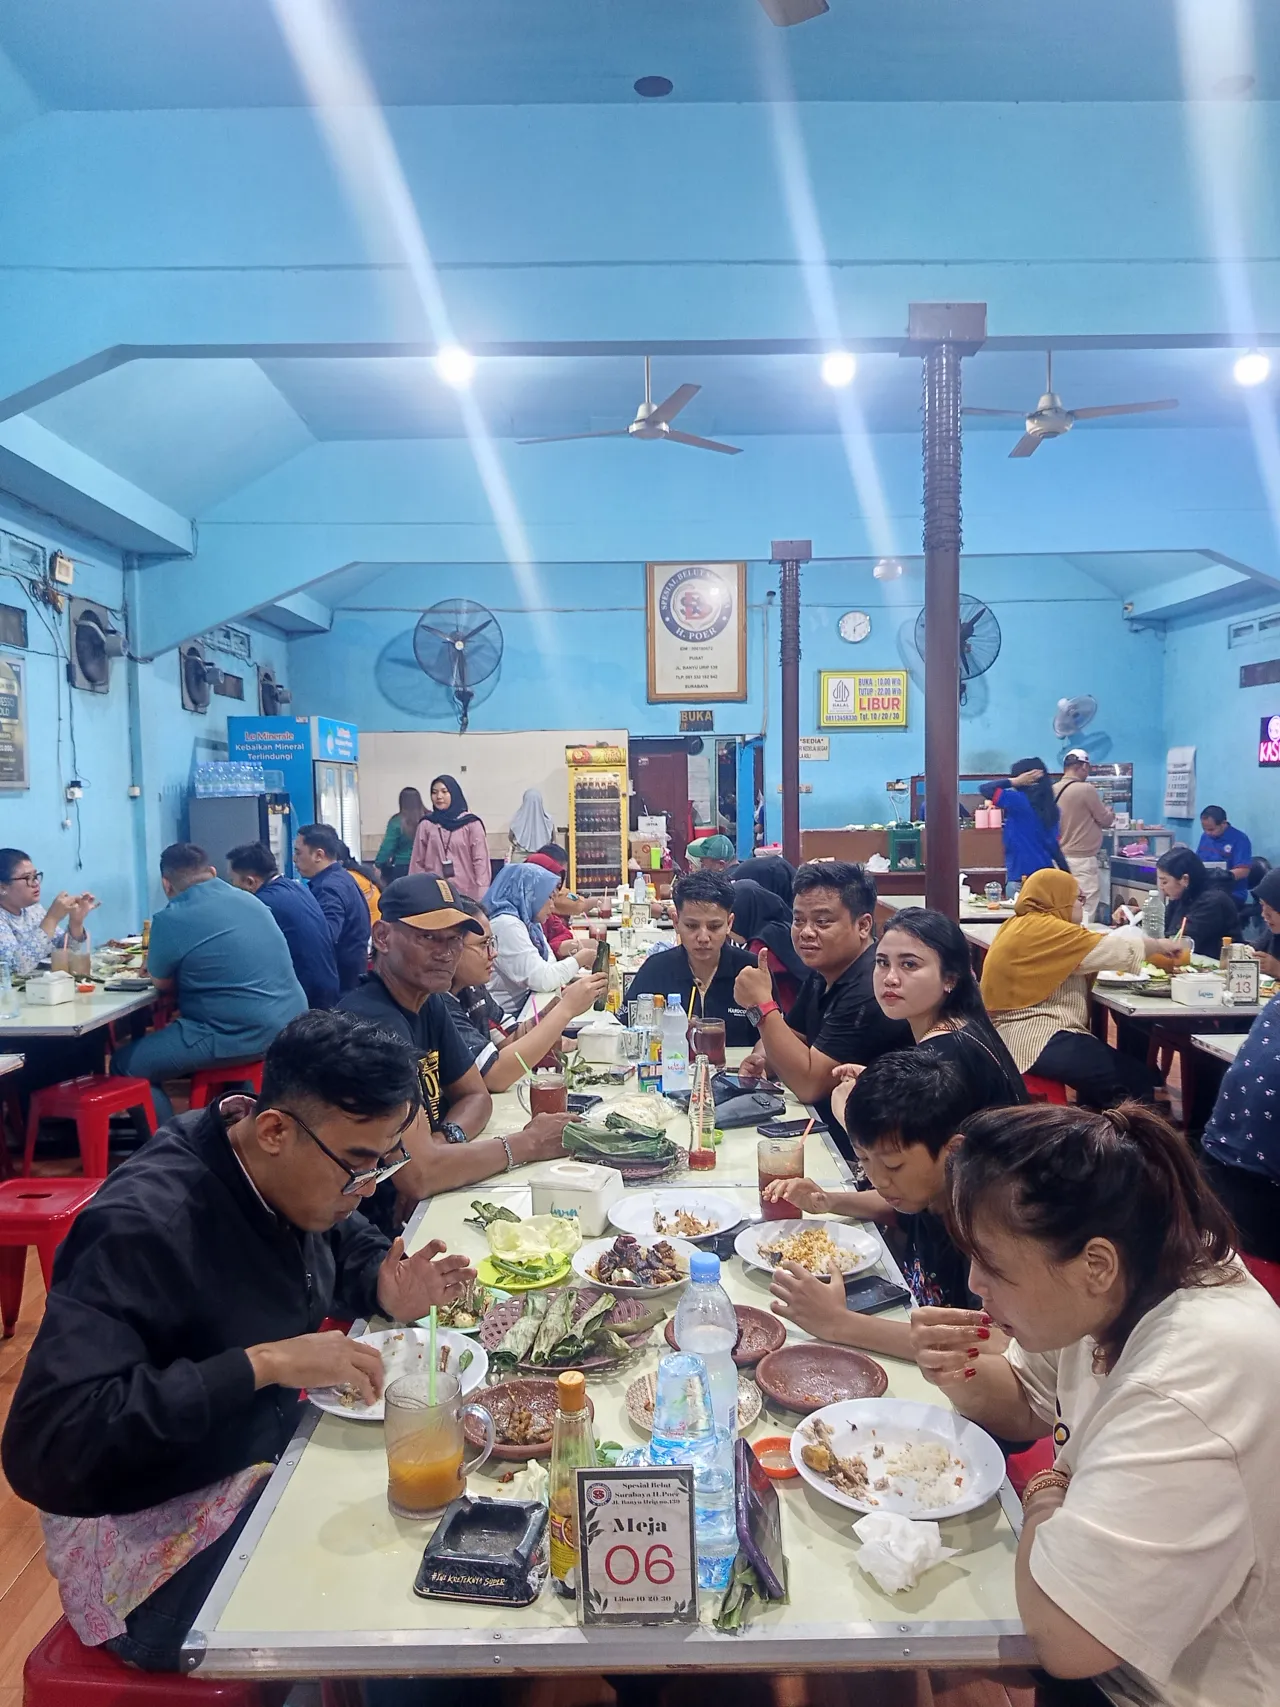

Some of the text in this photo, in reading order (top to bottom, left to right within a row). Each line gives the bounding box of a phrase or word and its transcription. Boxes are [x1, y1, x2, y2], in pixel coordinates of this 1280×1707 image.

[688, 627, 717, 640] POER
[859, 678, 872, 686] BUKA
[858, 688, 873, 696] TUTUP
[859, 697, 901, 711] LIBUR
[681, 711, 712, 722] BUKA
[892, 712, 900, 720] 30
[245, 731, 294, 741] Le Minerale
[235, 743, 305, 751] Kebaikan Mineral
[247, 753, 293, 761] Terlindungi
[1235, 981, 1252, 994] 13
[615, 1491, 651, 1499] Surabaya
[613, 1517, 667, 1536] Meja
[605, 1544, 675, 1586] 06
